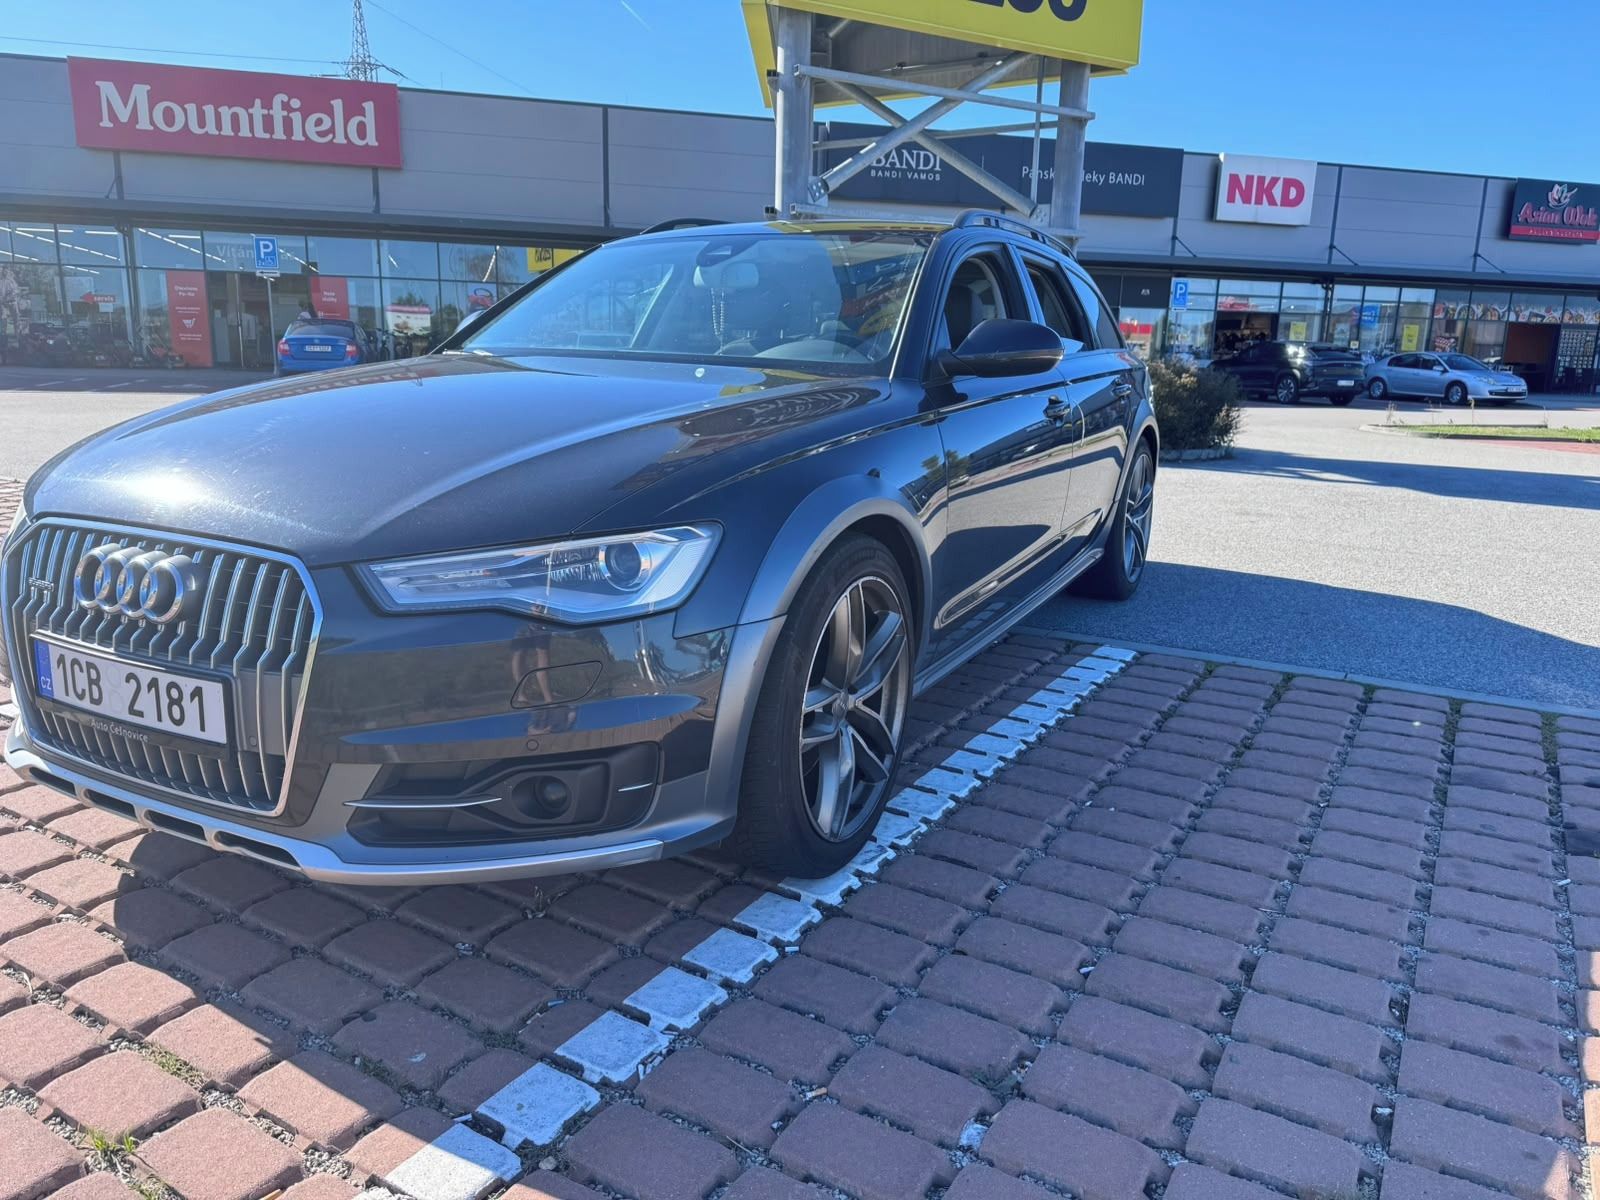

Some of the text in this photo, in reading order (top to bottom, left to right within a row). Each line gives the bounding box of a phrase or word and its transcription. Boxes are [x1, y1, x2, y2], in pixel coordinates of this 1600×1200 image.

[95, 80, 379, 146] Mountfield
[870, 168, 941, 181] BANDI VAMOS
[1021, 166, 1145, 186] Pnsk leky BANDI
[1226, 173, 1305, 208] NKD
[1517, 201, 1598, 226] Asian Wok
[260, 240, 273, 259] P
[1176, 284, 1186, 299] P
[40, 675, 52, 690] CZ
[56, 653, 206, 733] 1CB 2181
[90, 717, 109, 732] Auto
